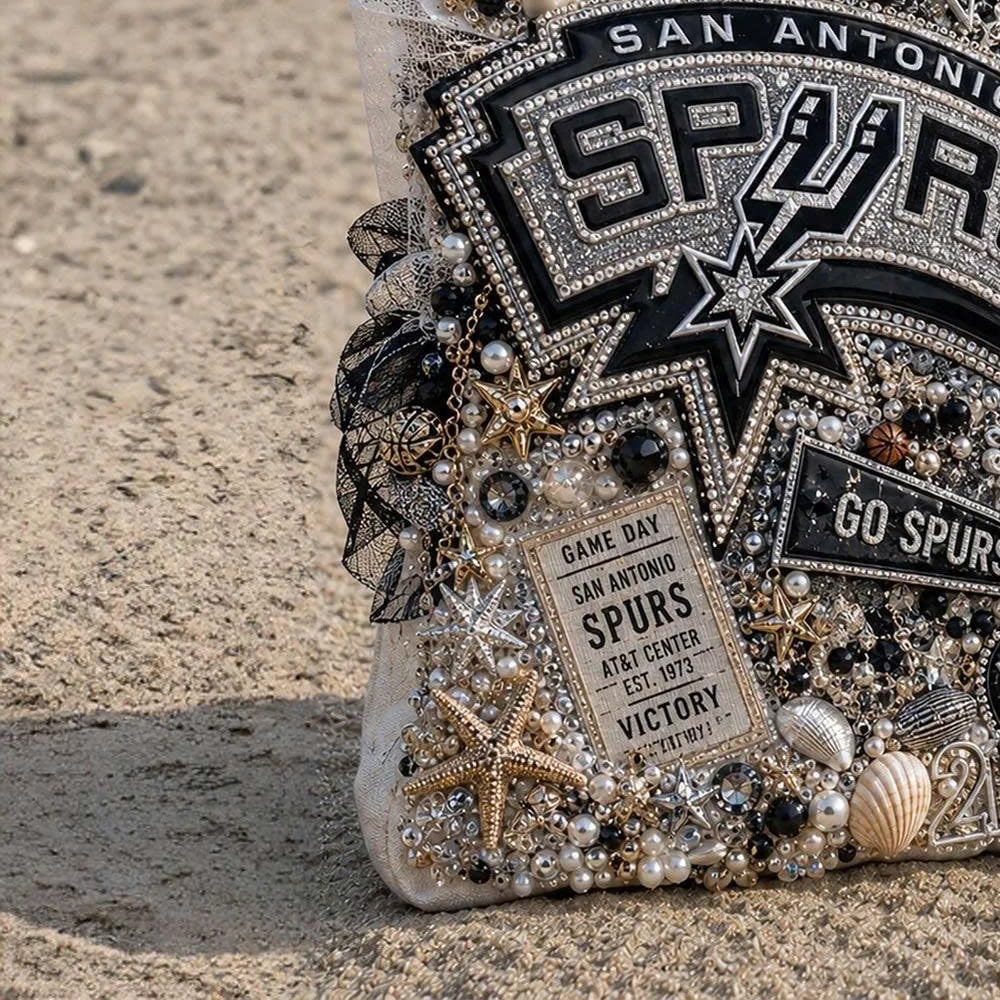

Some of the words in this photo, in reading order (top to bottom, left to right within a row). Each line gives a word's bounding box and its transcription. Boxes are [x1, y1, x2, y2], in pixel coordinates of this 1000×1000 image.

[608, 12, 735, 54] SAN
[561, 528, 616, 564] GAME
[625, 513, 661, 544] DAY
[834, 491, 890, 546] GO
[571, 578, 604, 605] SAN
[609, 553, 676, 592] ANTONIO
[582, 581, 694, 650] SPURS
[602, 649, 640, 679] AT&T
[645, 628, 702, 663] CENTER
[623, 672, 657, 696] EST.
[659, 658, 695, 683] 1973
[616, 684, 722, 740] VICTORY
